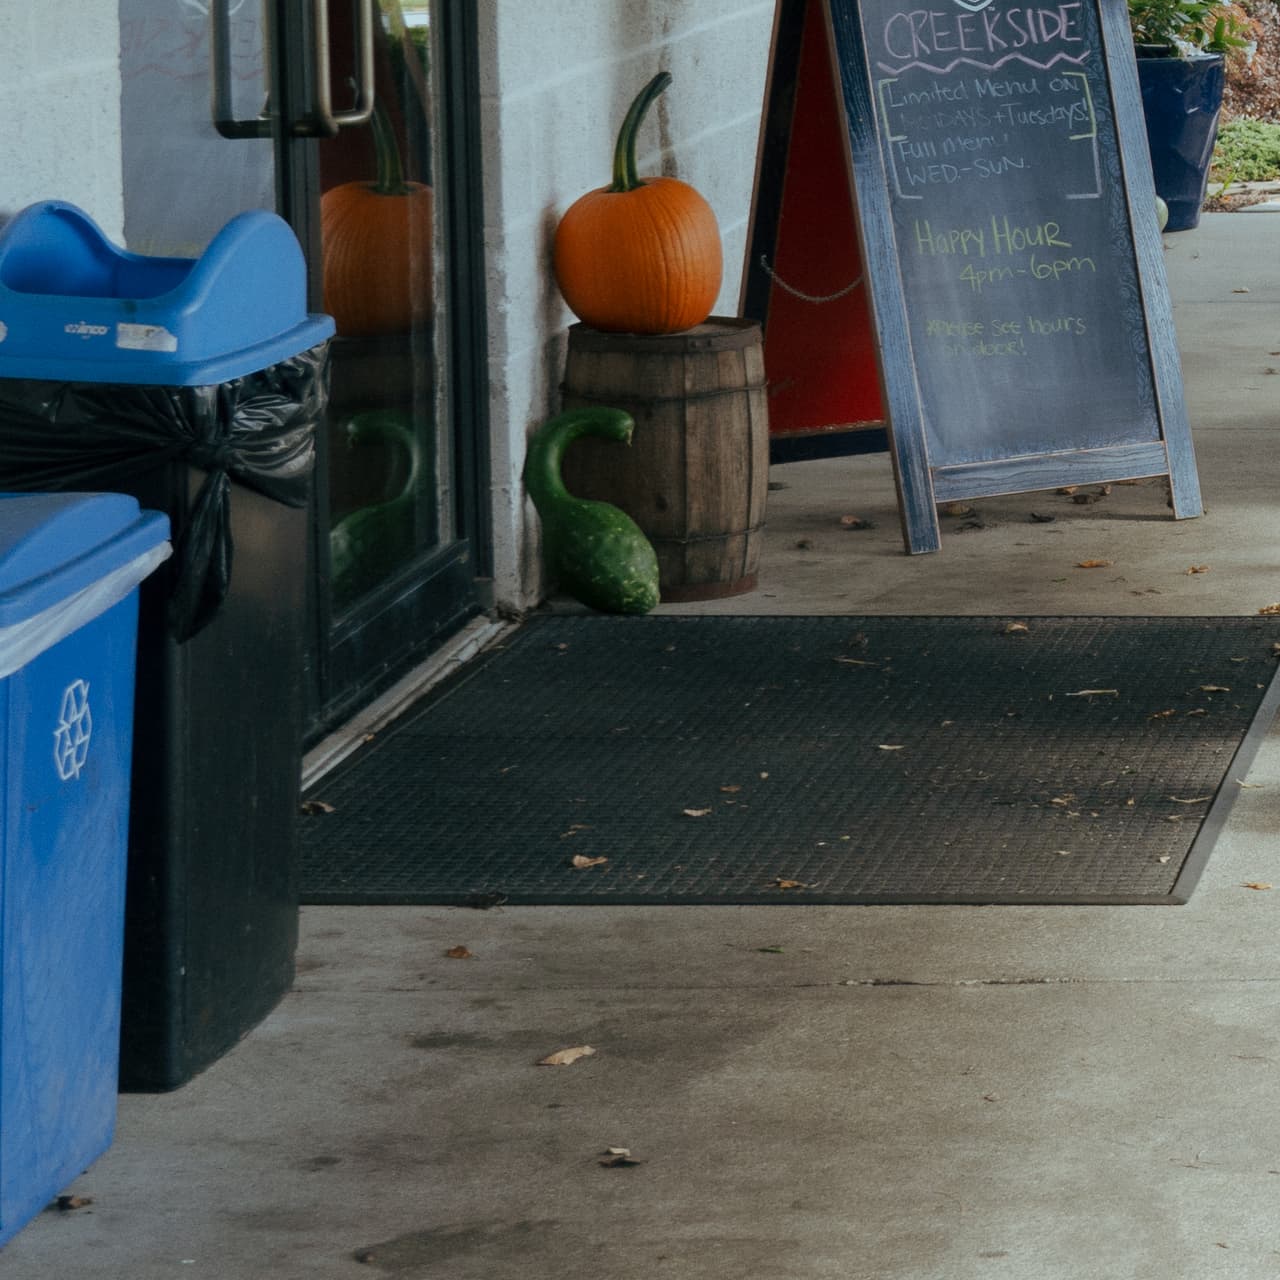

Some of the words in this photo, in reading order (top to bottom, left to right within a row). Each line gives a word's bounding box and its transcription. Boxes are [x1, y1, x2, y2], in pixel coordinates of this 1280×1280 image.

[884, 2, 1083, 59] CREEKSIDE
[887, 80, 969, 108] Limited
[974, 77, 1041, 98] Menu
[898, 140, 937, 163] Full
[914, 219, 985, 258] Happy
[1027, 315, 1088, 336] hours
